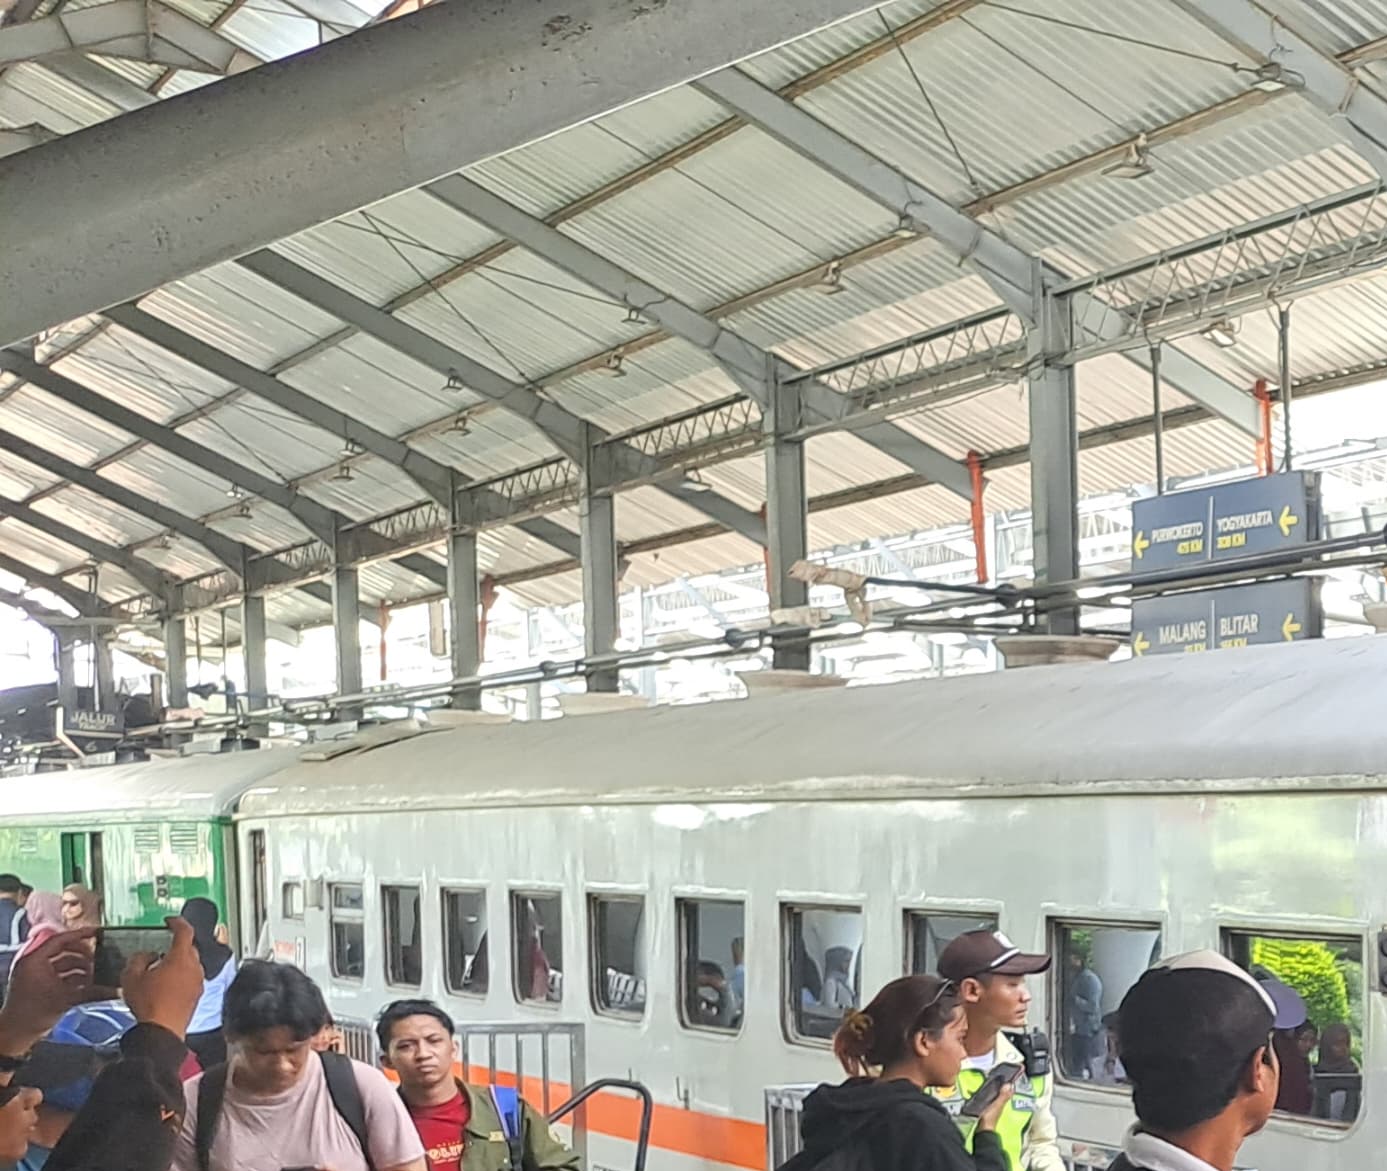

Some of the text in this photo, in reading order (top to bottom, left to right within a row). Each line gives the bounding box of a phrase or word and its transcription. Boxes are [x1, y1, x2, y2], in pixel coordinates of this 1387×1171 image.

[1216, 510, 1273, 533] YOGYAKARTA
[1159, 620, 1207, 645] MALANG
[1220, 613, 1259, 637] BLITAR
[70, 711, 117, 726] JALUR
